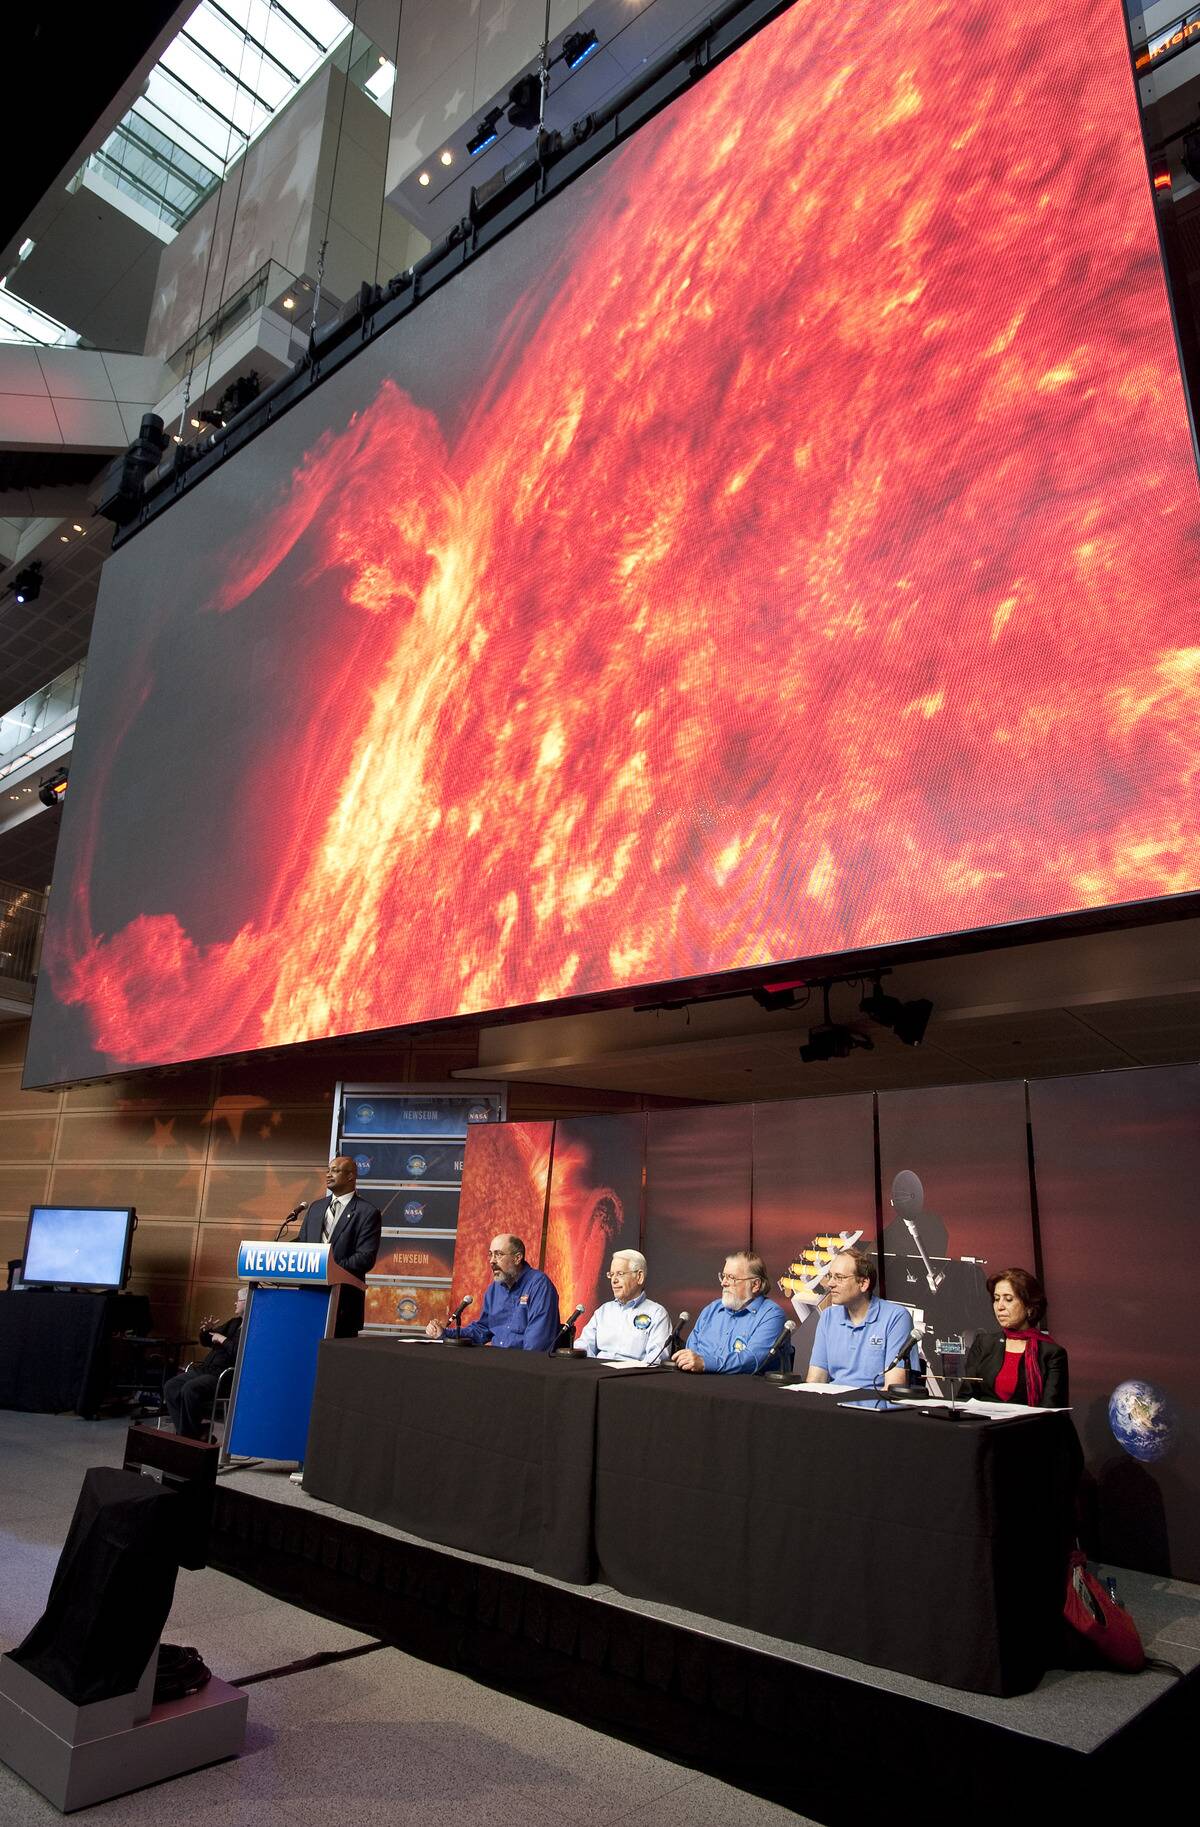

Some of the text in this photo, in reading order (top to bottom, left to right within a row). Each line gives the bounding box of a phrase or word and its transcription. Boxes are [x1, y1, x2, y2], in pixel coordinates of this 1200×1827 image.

[403, 1110, 438, 1120] NEWSEUM
[468, 1112, 488, 1120] NASA
[404, 1208, 423, 1216] NASA
[245, 1249, 321, 1273] NEWSEUM
[393, 1253, 429, 1264] NEWSEUM
